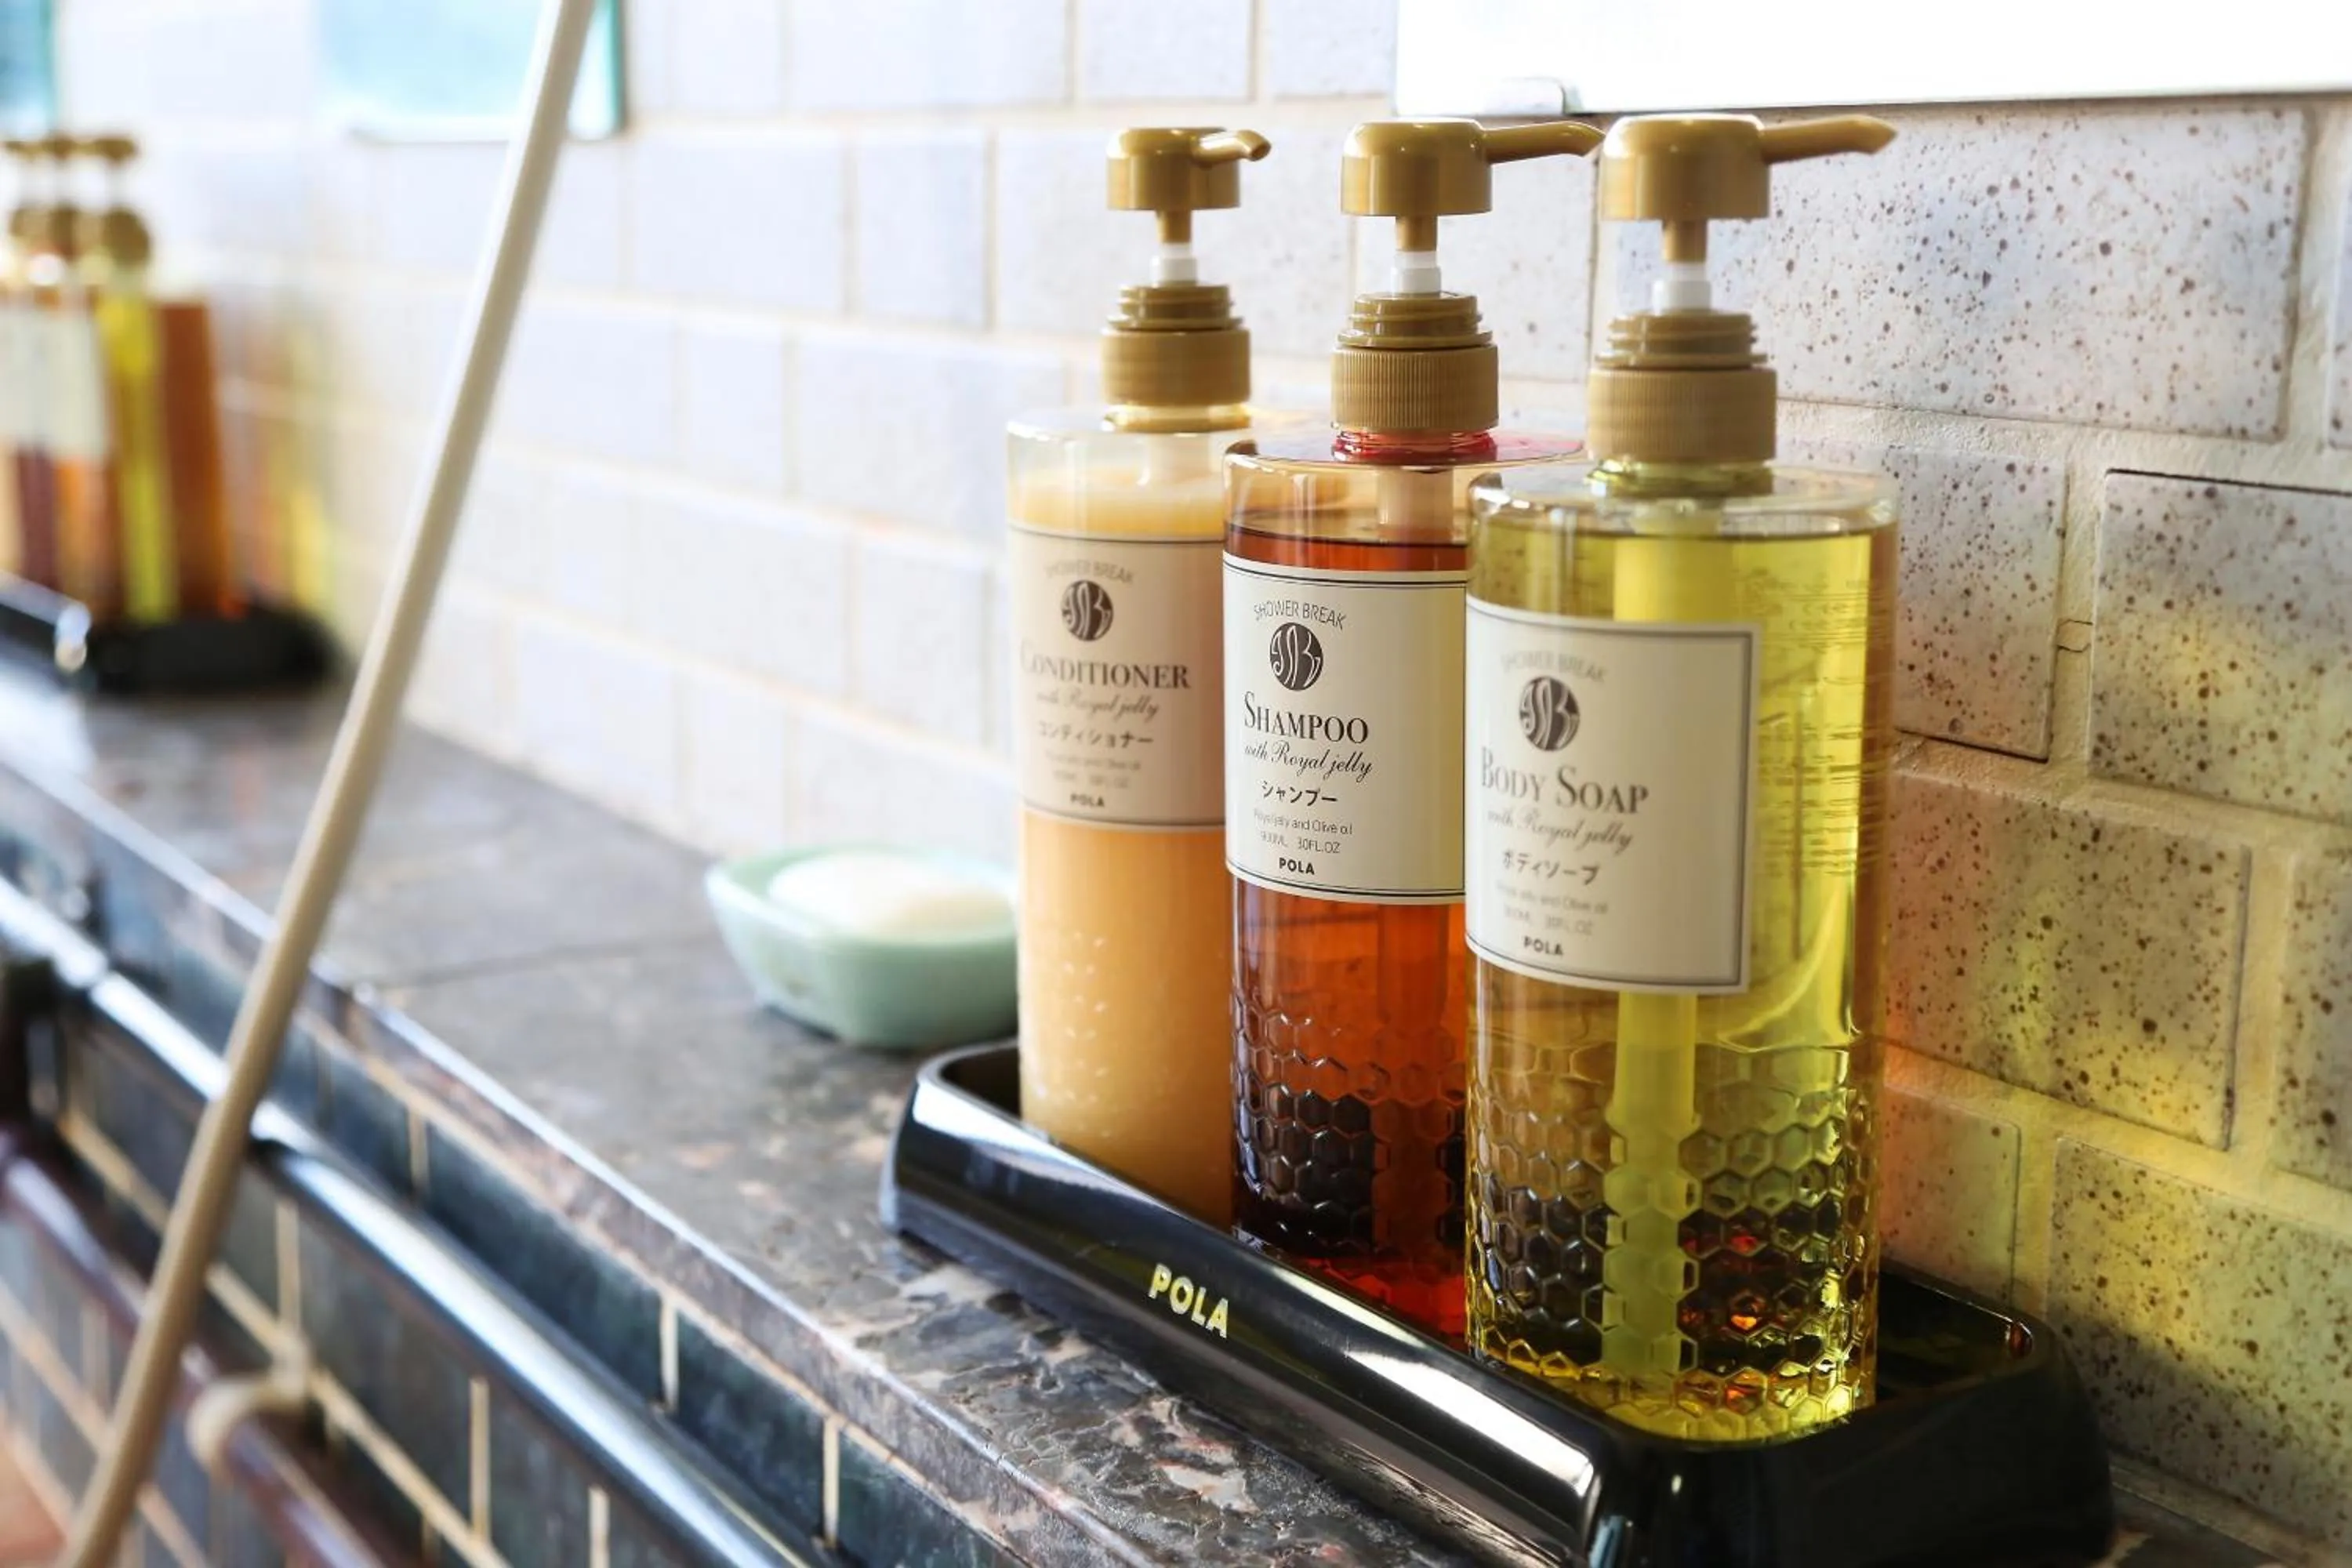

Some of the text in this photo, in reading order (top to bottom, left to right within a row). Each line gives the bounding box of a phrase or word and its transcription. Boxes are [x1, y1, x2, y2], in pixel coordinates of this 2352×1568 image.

[1254, 600, 1347, 630] SHOWER BREAK
[1244, 691, 1369, 744] SHAMPOO
[1244, 739, 1372, 783] with Royal jelly
[1261, 780, 1338, 807] シャンプー
[1482, 746, 1650, 815] BODY SOAP
[1070, 793, 1105, 808] POLA
[1279, 857, 1316, 875] POLA
[1524, 935, 1564, 956] POLA
[1148, 1262, 1229, 1339] POLA
